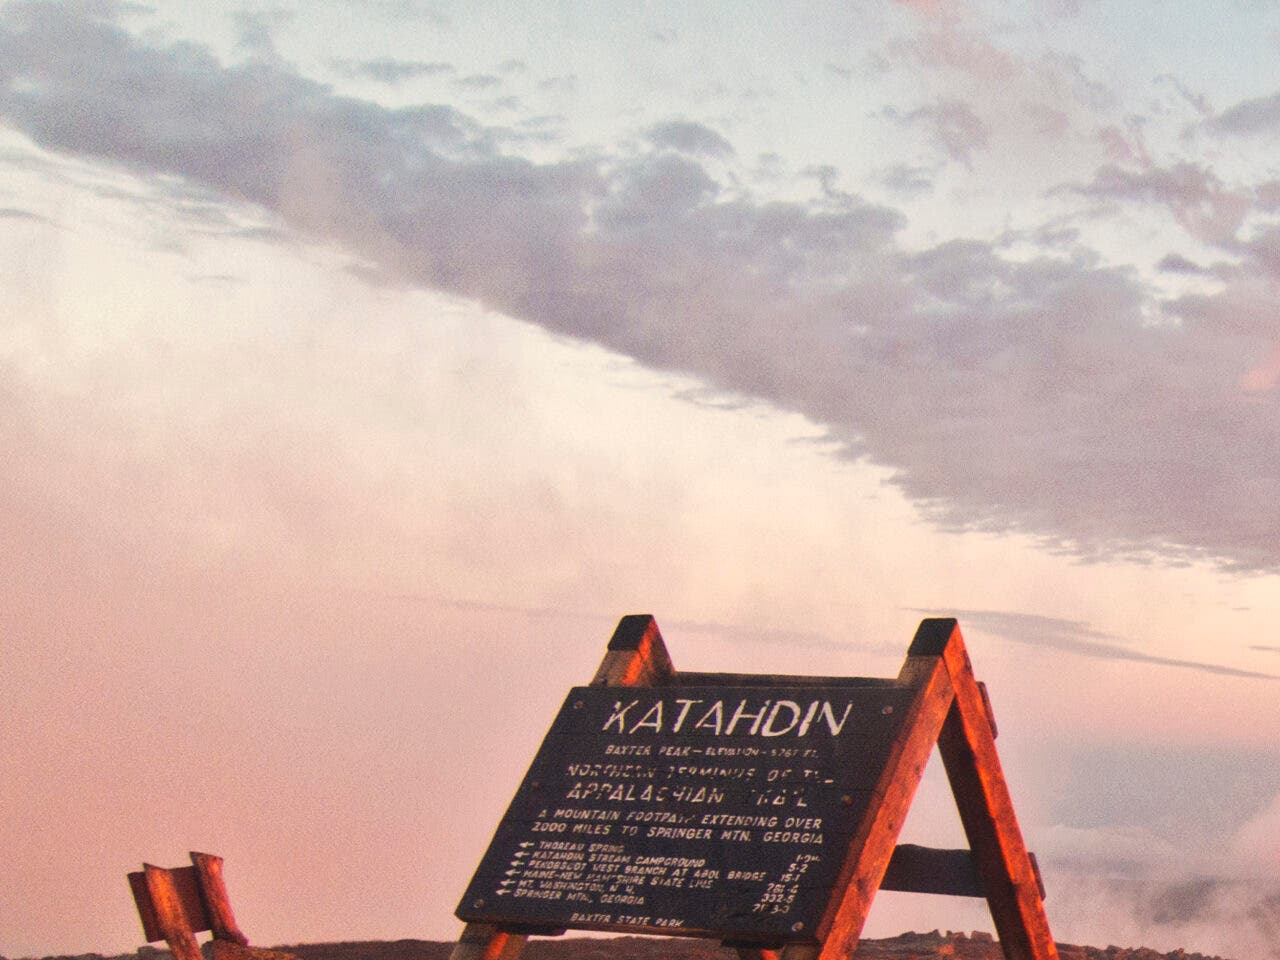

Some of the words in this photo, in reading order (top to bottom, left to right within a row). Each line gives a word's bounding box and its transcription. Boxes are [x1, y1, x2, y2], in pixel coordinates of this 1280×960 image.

[602, 699, 853, 737] KATAHDIN
[605, 744, 651, 756] BAXTER
[659, 746, 691, 756] PEAK
[538, 809, 548, 818] A
[553, 808, 621, 821] MOUNTAIN
[701, 814, 778, 828] EXTENDING
[784, 817, 823, 830] OVER
[531, 821, 568, 833] 2000
[572, 823, 612, 835] MILES
[621, 825, 639, 837] TO
[646, 826, 713, 840] SPRINGER
[763, 831, 823, 844] GEORGIA
[539, 841, 586, 852] THOREAU
[531, 850, 586, 861] KATAHDIN
[588, 853, 632, 864] STREAM
[635, 856, 706, 868] CAMPGROUND
[592, 863, 621, 873] WEST
[624, 865, 668, 876] BRANCH
[671, 868, 689, 878] AT
[727, 870, 767, 882] BRIDGE
[650, 876, 685, 888] STATE
[600, 894, 646, 906] GEORGIA
[570, 912, 612, 923] BAXTER
[616, 915, 652, 926] STATE
[655, 918, 685, 928] PARK
